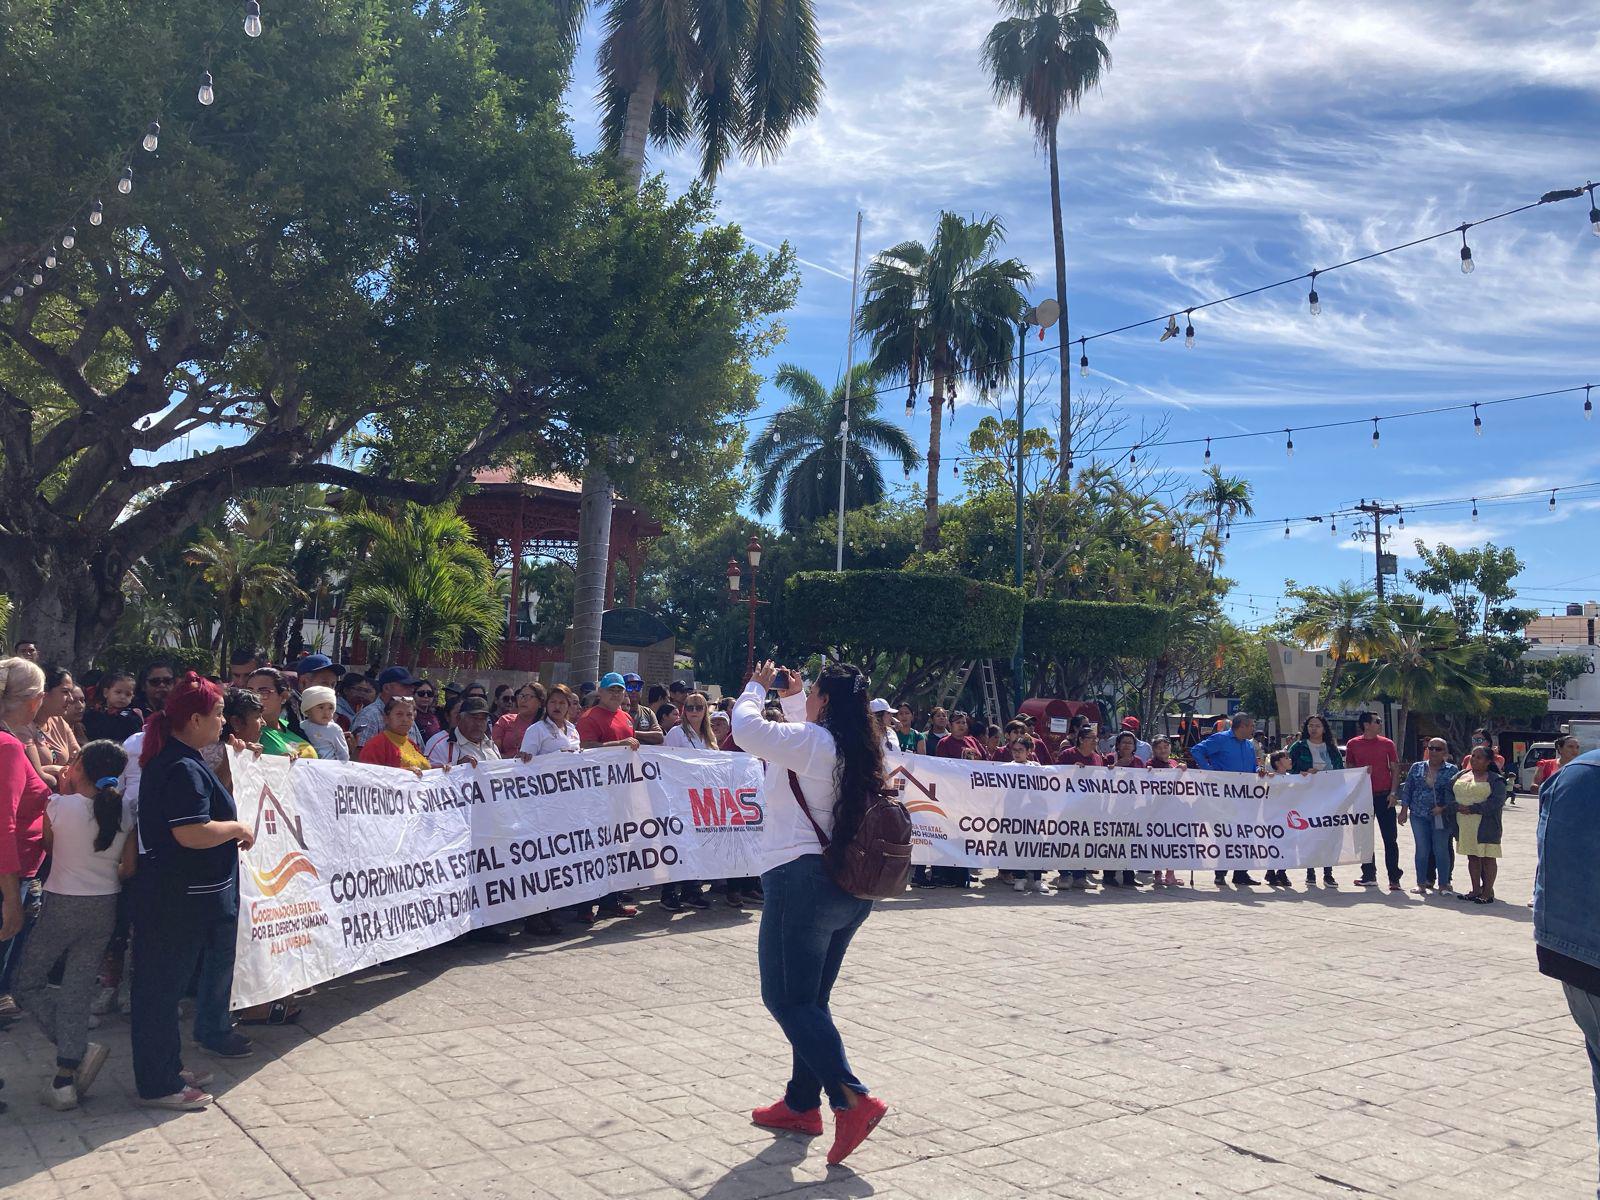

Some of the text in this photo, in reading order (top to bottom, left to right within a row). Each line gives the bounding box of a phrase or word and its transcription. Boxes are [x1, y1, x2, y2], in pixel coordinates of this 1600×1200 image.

[335, 761, 662, 820] ¡BIENVENIDO A SINALOA PRESIDENTE AMLO!
[971, 771, 1270, 800] ¡BIENVENIDO A SINALOA PRESIDENTE AMLO!
[688, 788, 763, 826] MAS
[1286, 809, 1371, 831] Guasave
[922, 831, 948, 840] HUMANO
[958, 815, 1285, 839] COORDINADORA ESTATAL SOLICITA SU APOYO
[330, 858, 448, 903] COORDINADORA
[509, 828, 594, 865] SOLICITA
[597, 825, 612, 847] SU
[613, 816, 684, 844] APOYO
[965, 839, 1285, 859] PARA VIVIENDA DIGNA EN NUESTRO ESTADO.
[341, 845, 683, 948] PARA VIVIENDA DIGNA EN NUESTRO ESTADO.
[251, 925, 266, 941] POR
[267, 924, 275, 938] EL
